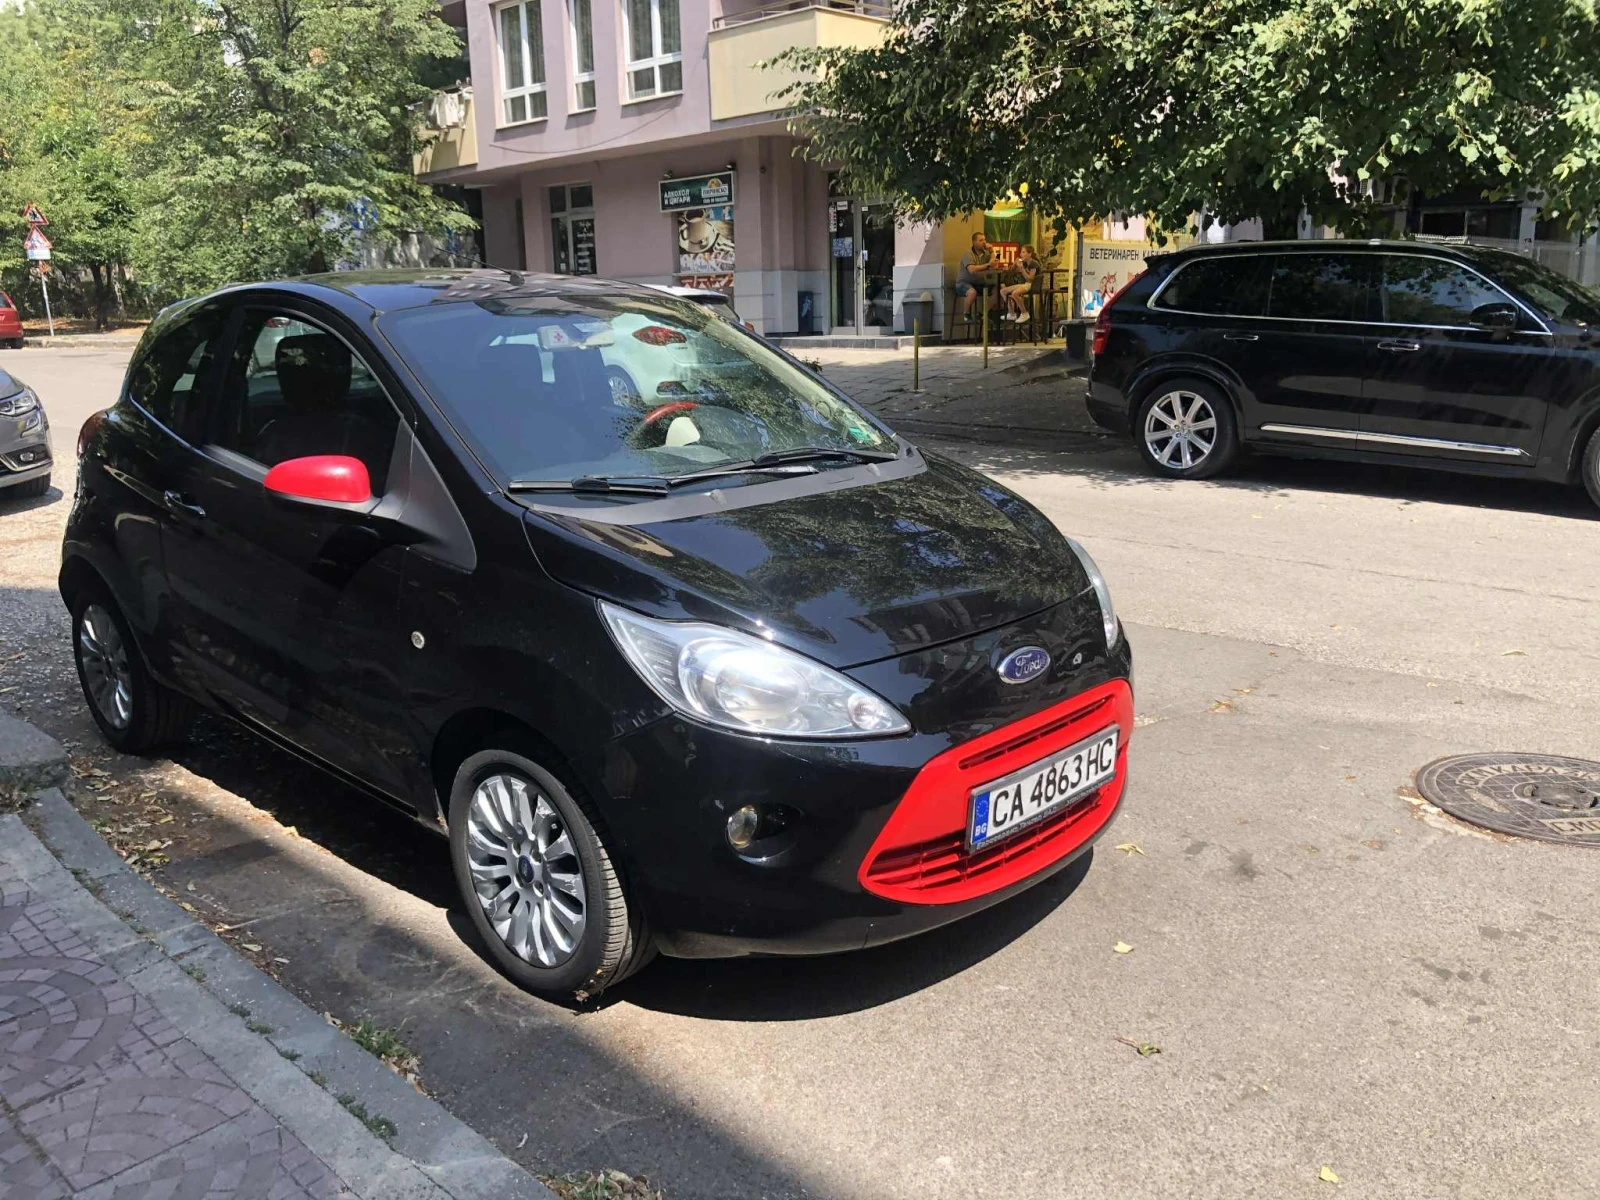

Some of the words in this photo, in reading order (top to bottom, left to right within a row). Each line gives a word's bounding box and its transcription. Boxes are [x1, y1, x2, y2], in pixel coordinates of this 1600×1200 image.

[664, 188, 690, 198] АЛКОХОЛ
[1089, 248, 1140, 261] ВЕТЕРИНАРЕН
[1015, 653, 1042, 677] Ford
[992, 783, 1024, 828] CA
[1030, 754, 1083, 808] 4863
[1086, 737, 1113, 781] HC
[975, 822, 987, 837] BG
